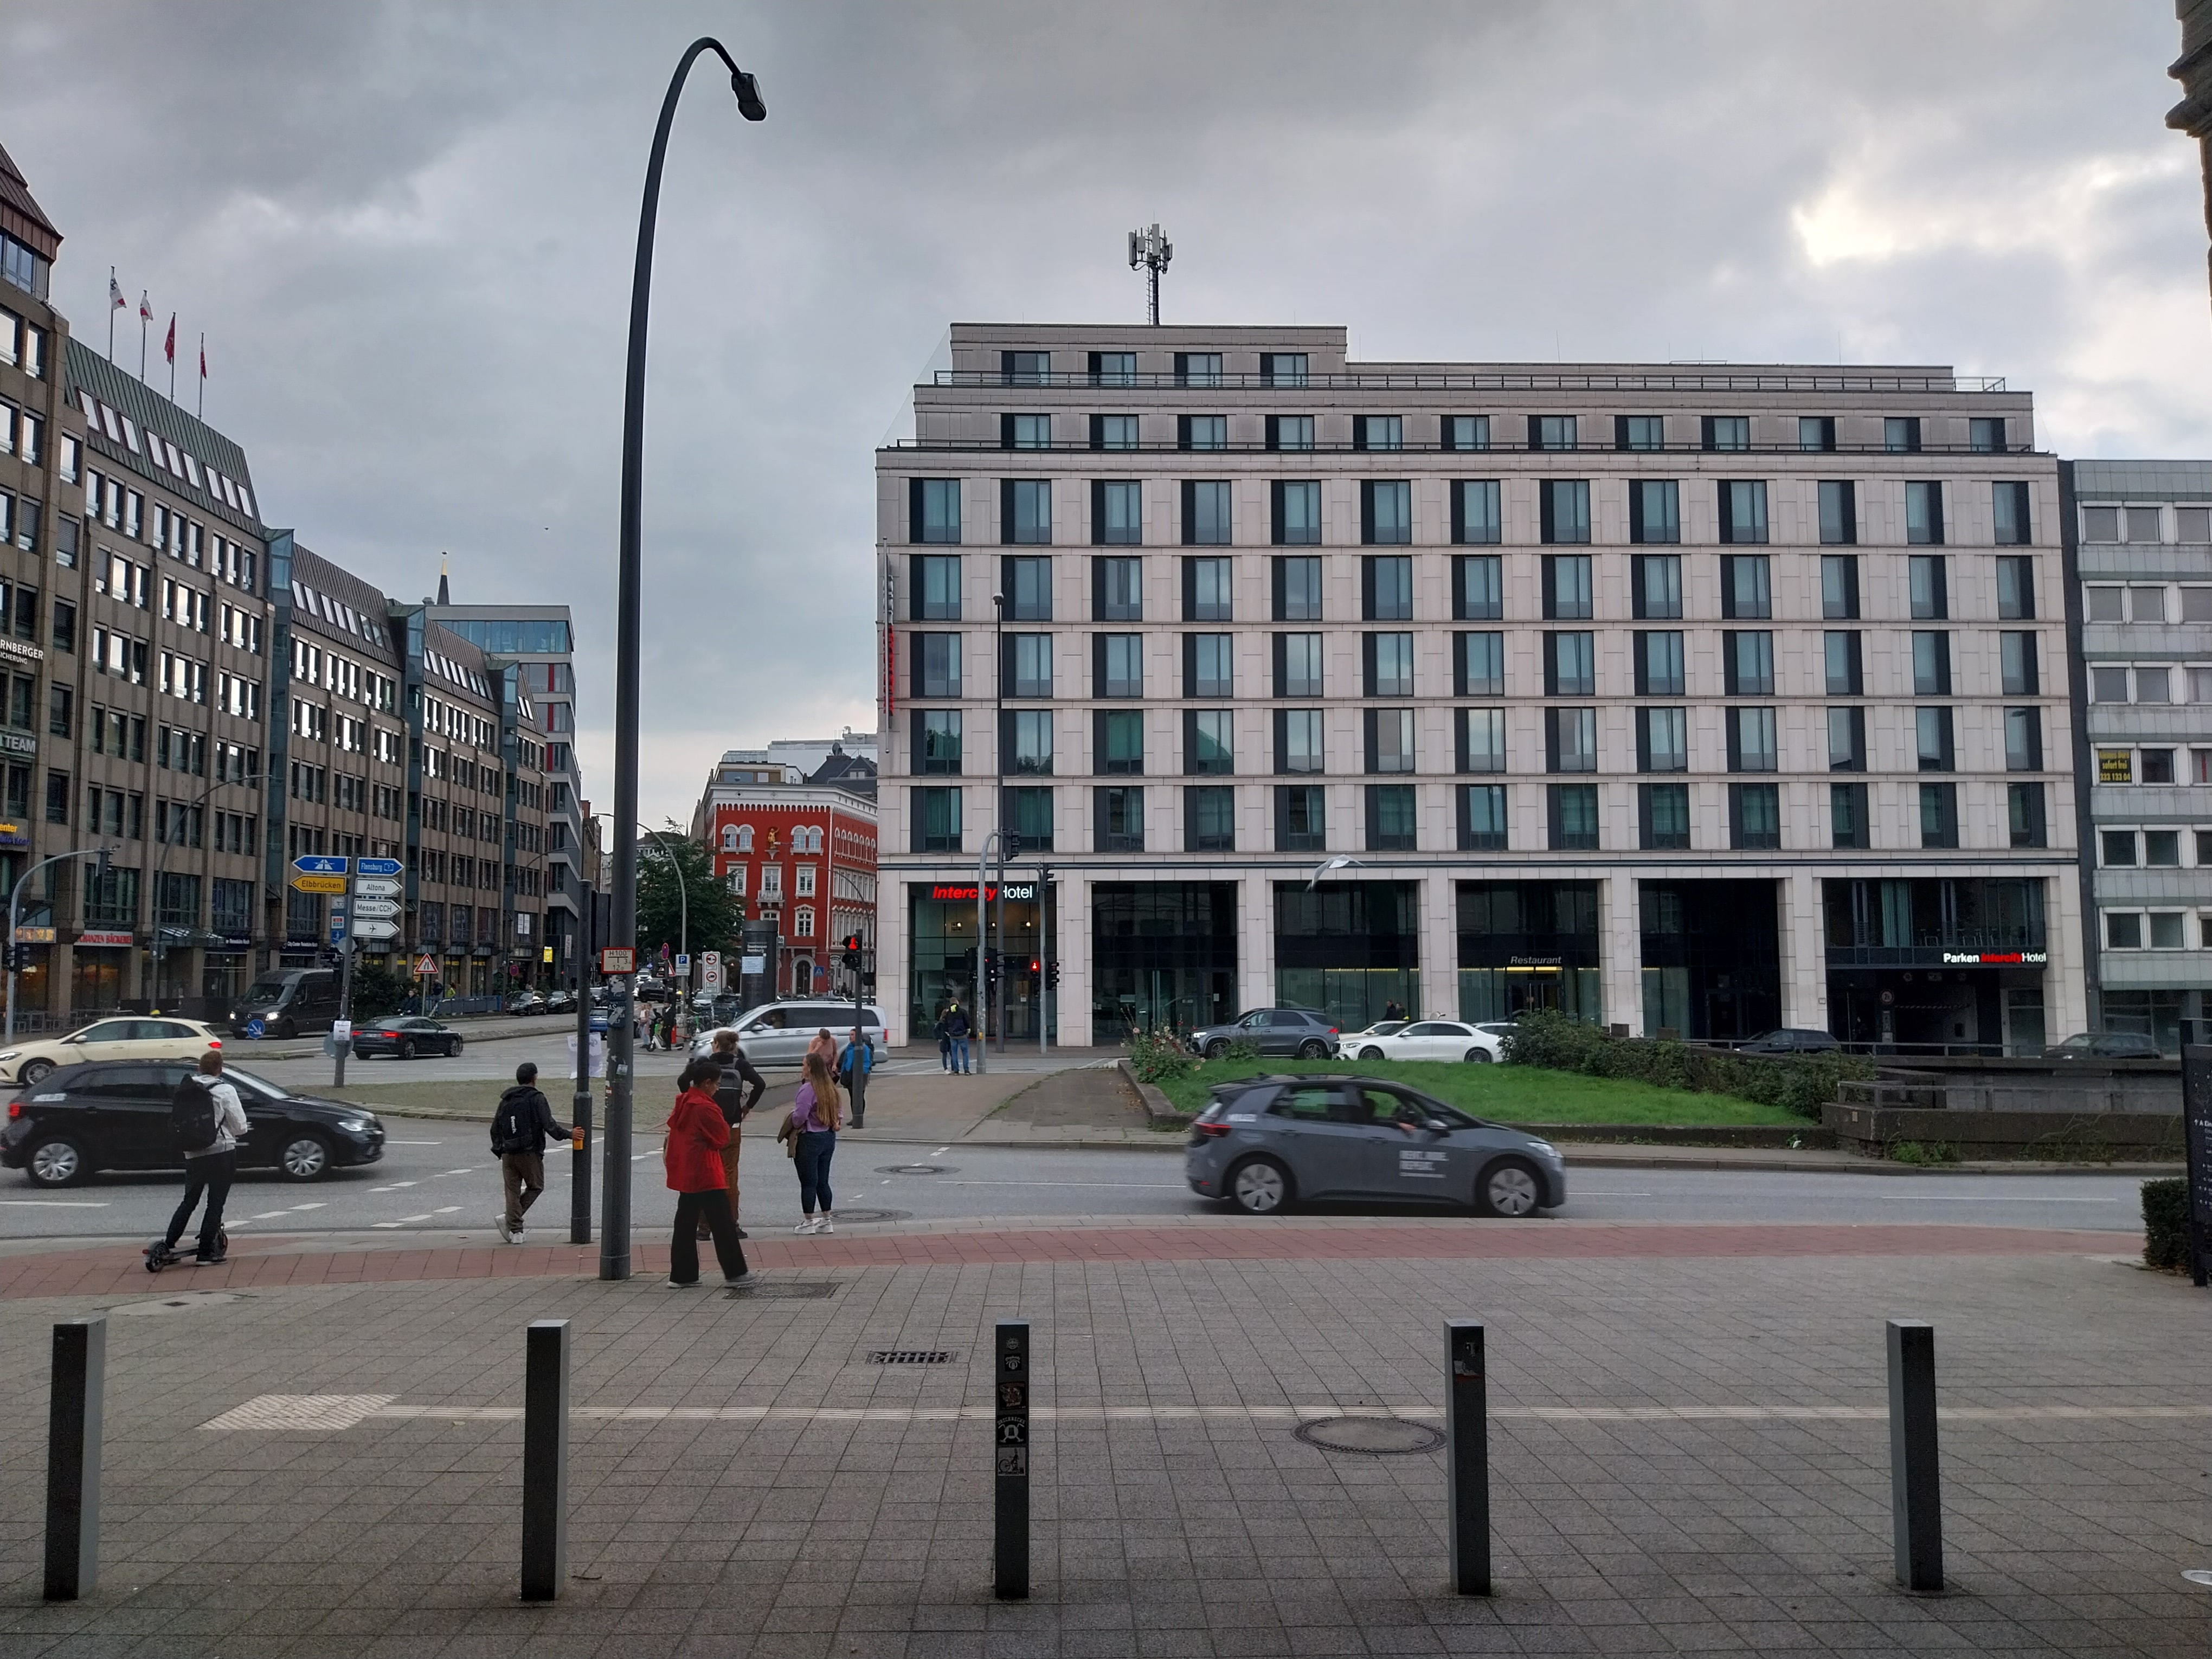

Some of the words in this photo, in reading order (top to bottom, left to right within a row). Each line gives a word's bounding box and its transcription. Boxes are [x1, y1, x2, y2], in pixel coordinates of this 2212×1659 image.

[0, 639, 44, 660] RNBERGER
[4, 735, 36, 754] TEAM
[2118, 759, 2127, 769] frei
[0, 823, 18, 833] enter
[361, 862, 383, 872] Flensburg
[301, 880, 341, 889] Elbbrücken
[366, 883, 385, 891] Altona
[357, 904, 393, 912] Messe/CCH
[1510, 956, 1562, 964] Restaurant
[1943, 953, 1979, 963] Parken
